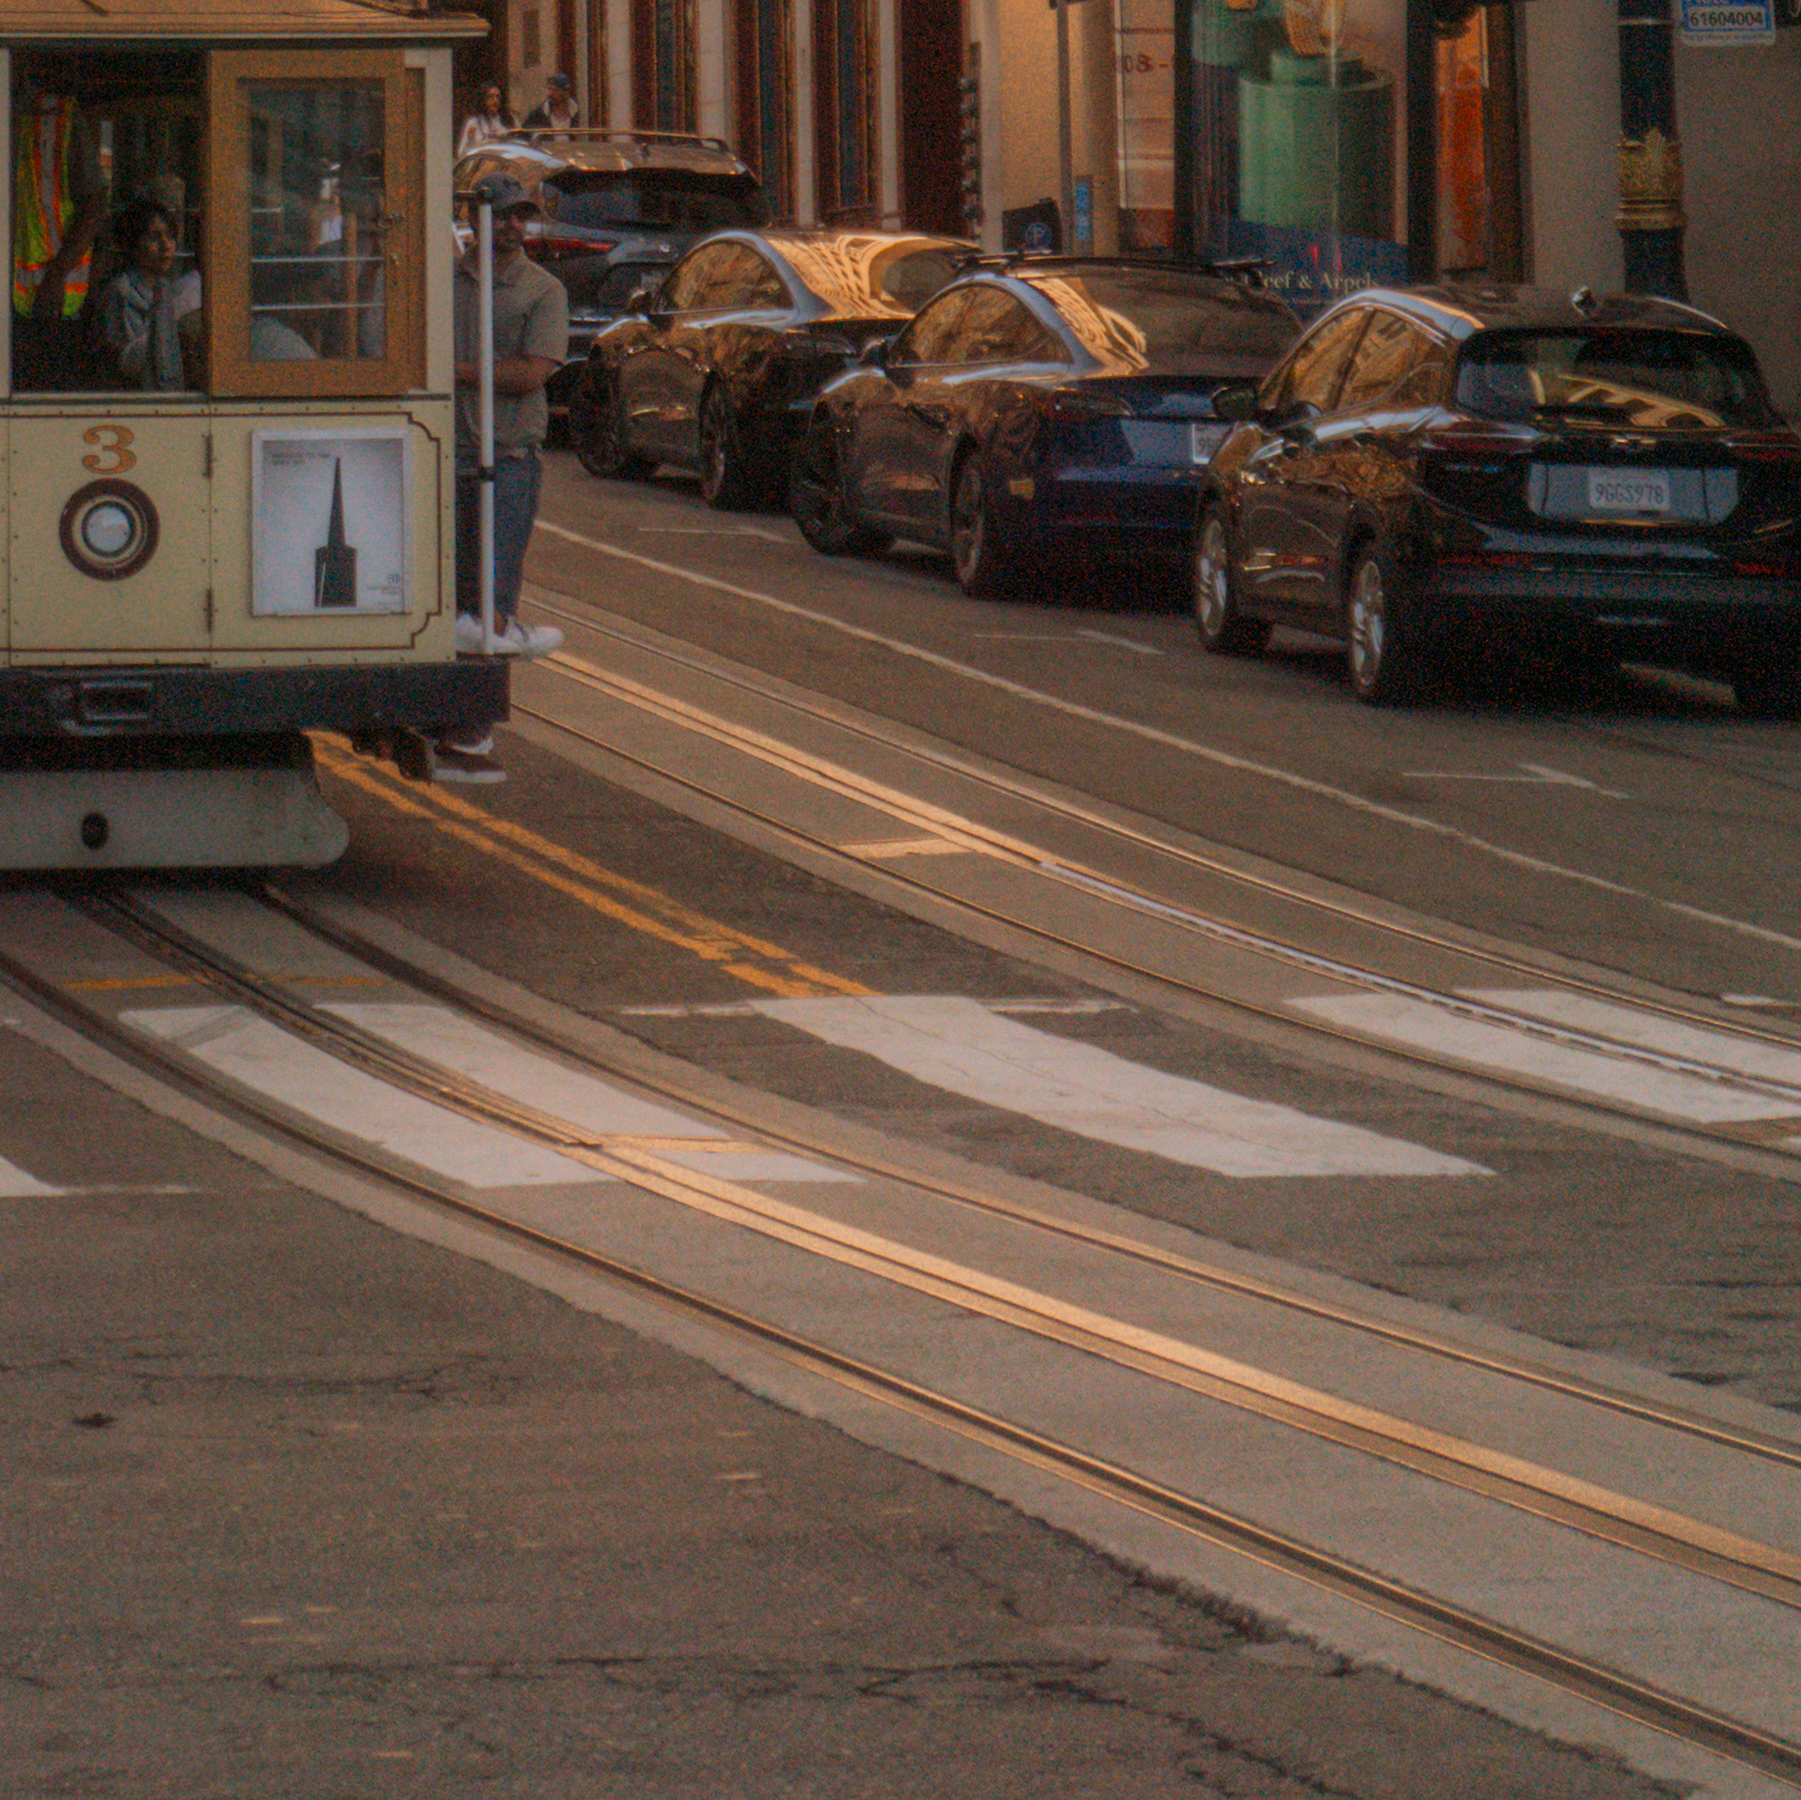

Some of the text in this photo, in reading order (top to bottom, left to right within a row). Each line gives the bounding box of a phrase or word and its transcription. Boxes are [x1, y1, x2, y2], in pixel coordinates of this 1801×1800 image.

[1690, 11, 1763, 26] 61604004
[1299, 272, 1313, 290] &
[82, 424, 138, 475] 3
